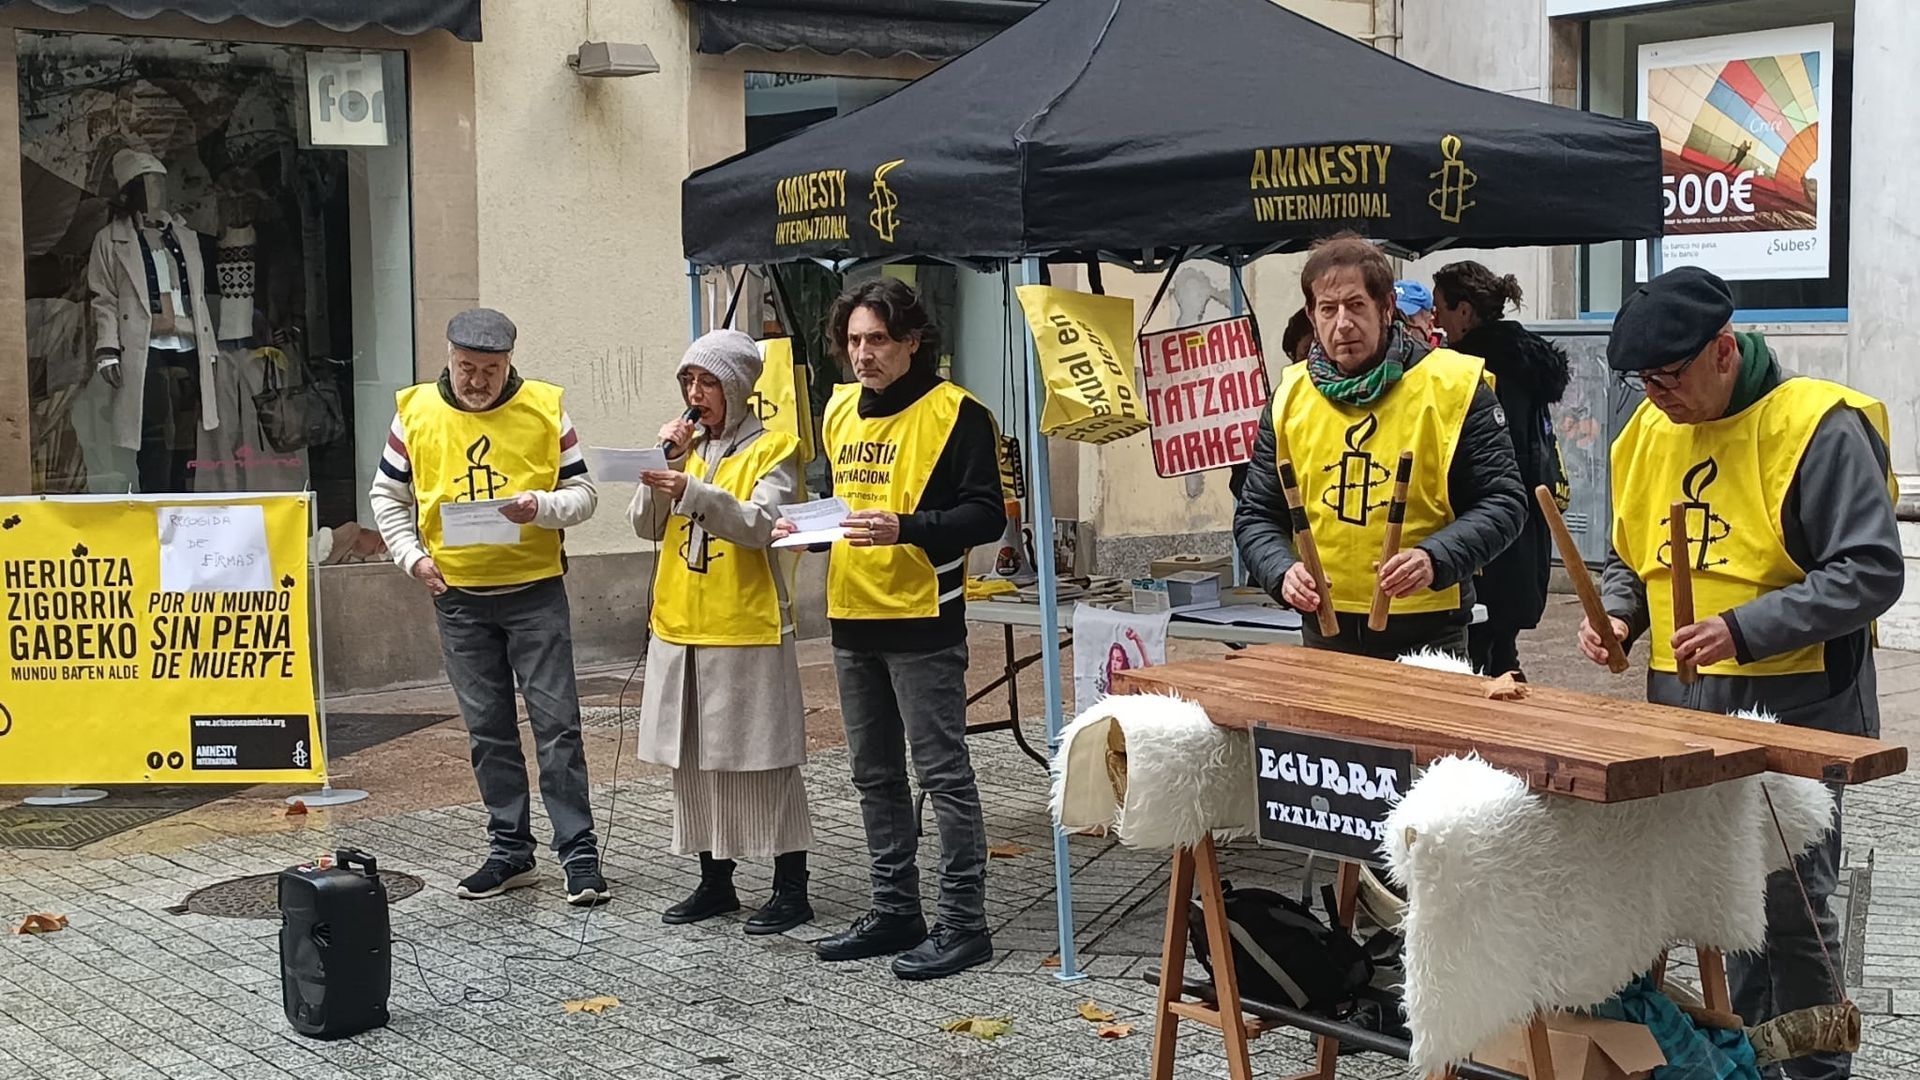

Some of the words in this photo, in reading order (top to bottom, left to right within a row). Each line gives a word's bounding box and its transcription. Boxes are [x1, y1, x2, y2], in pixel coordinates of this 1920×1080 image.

[1250, 145, 1392, 190] AMNESTY
[776, 169, 847, 216] AMNESTY
[1253, 192, 1391, 222] INTERNATIONAL
[775, 215, 850, 246] INTERNATIONAL
[1767, 237, 1817, 256] ¿Subes?
[5, 558, 133, 588] HERIOTZA
[201, 552, 255, 568] FIRMAS
[7, 590, 134, 620] ZIGORRIK
[148, 592, 185, 613] POR
[191, 591, 216, 613] UN
[221, 590, 291, 613] MUNDO
[10, 623, 137, 660] GABEKO
[150, 615, 201, 650] SIN
[212, 614, 291, 650] PENA
[11, 666, 57, 680] MUNDU
[62, 665, 104, 680] BATEN
[108, 665, 139, 680] ALDE
[151, 652, 183, 679] DE
[189, 651, 296, 679] MUERTE
[196, 745, 238, 757] AMNESTY
[1259, 747, 1400, 801] EGURRA
[1266, 801, 1388, 841] TXALAPART
